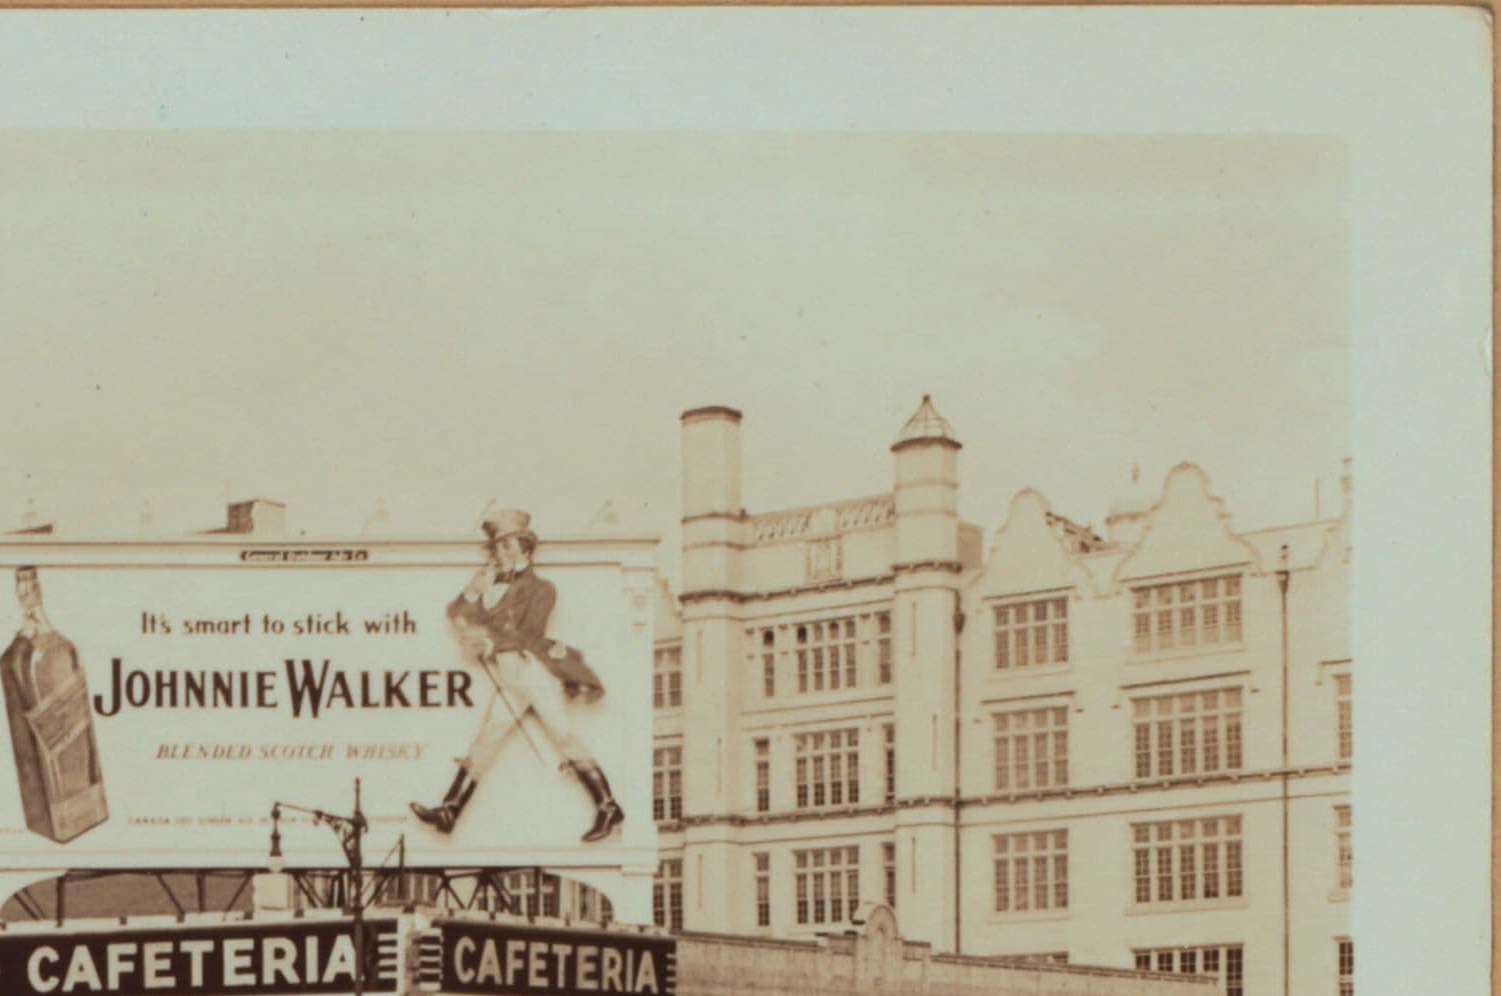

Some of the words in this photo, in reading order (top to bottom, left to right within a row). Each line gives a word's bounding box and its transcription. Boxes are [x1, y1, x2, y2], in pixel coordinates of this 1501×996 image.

[141, 611, 172, 634] It's
[183, 611, 251, 635] smart
[263, 611, 285, 635] to
[293, 610, 349, 635] stick
[364, 610, 417, 634] with
[94, 658, 278, 717] JOHNNIE
[285, 659, 475, 719] WALKER
[155, 743, 252, 761] BLENDED
[258, 743, 334, 761] SCOTCH
[345, 743, 428, 761] WHISKY
[26, 934, 365, 993] CAFETERIA
[453, 934, 660, 995] CAFETERIA
